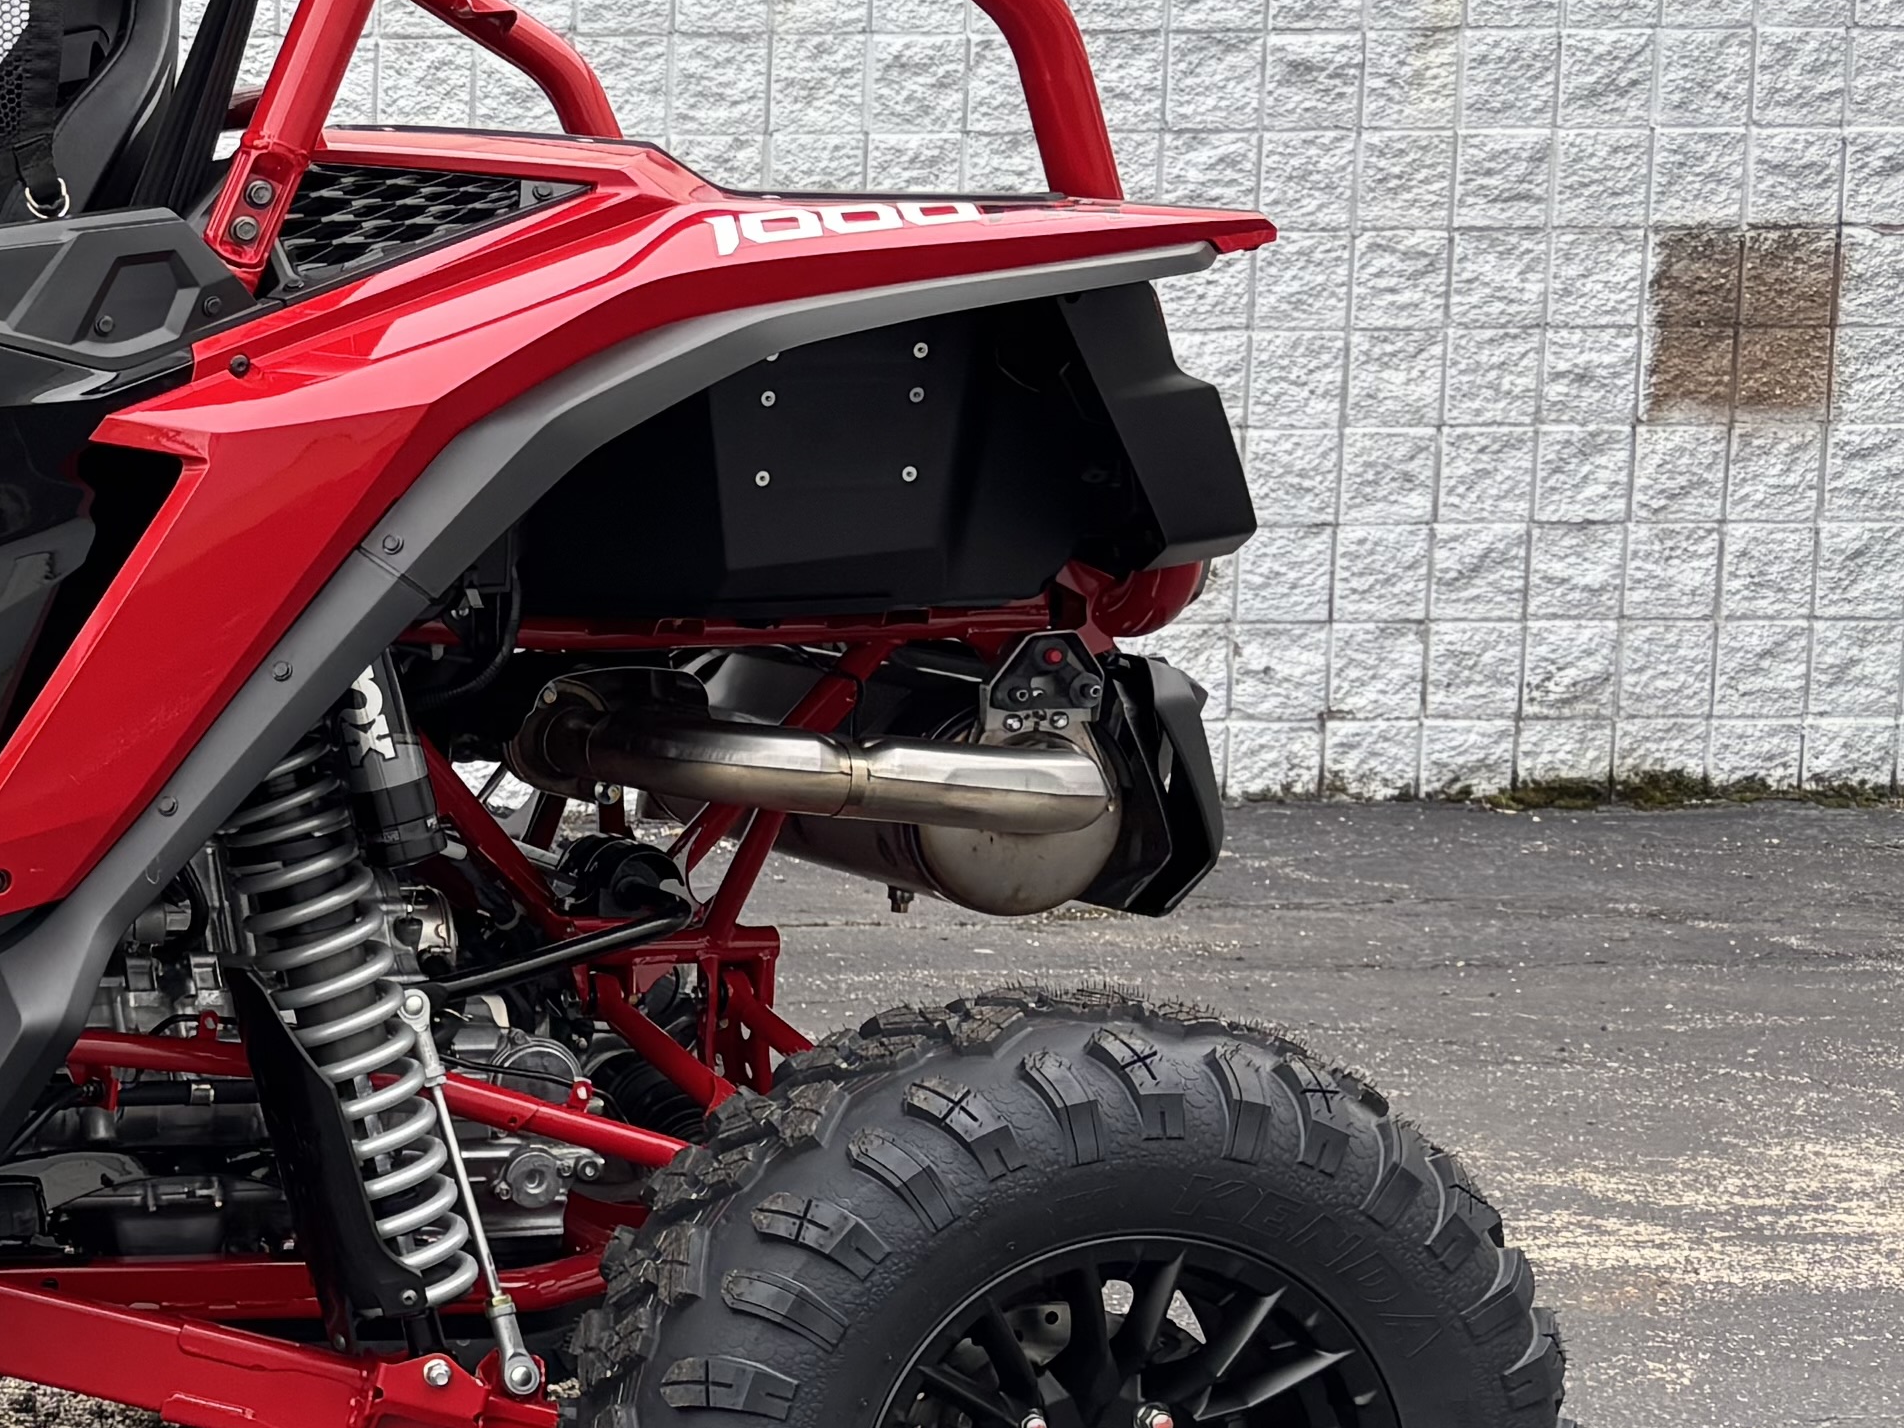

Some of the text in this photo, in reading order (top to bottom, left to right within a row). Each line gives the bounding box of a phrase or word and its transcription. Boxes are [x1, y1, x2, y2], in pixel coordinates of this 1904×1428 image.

[703, 202, 983, 256] 1000
[341, 664, 396, 767] OX
[1171, 1173, 1442, 1358] KENDA
